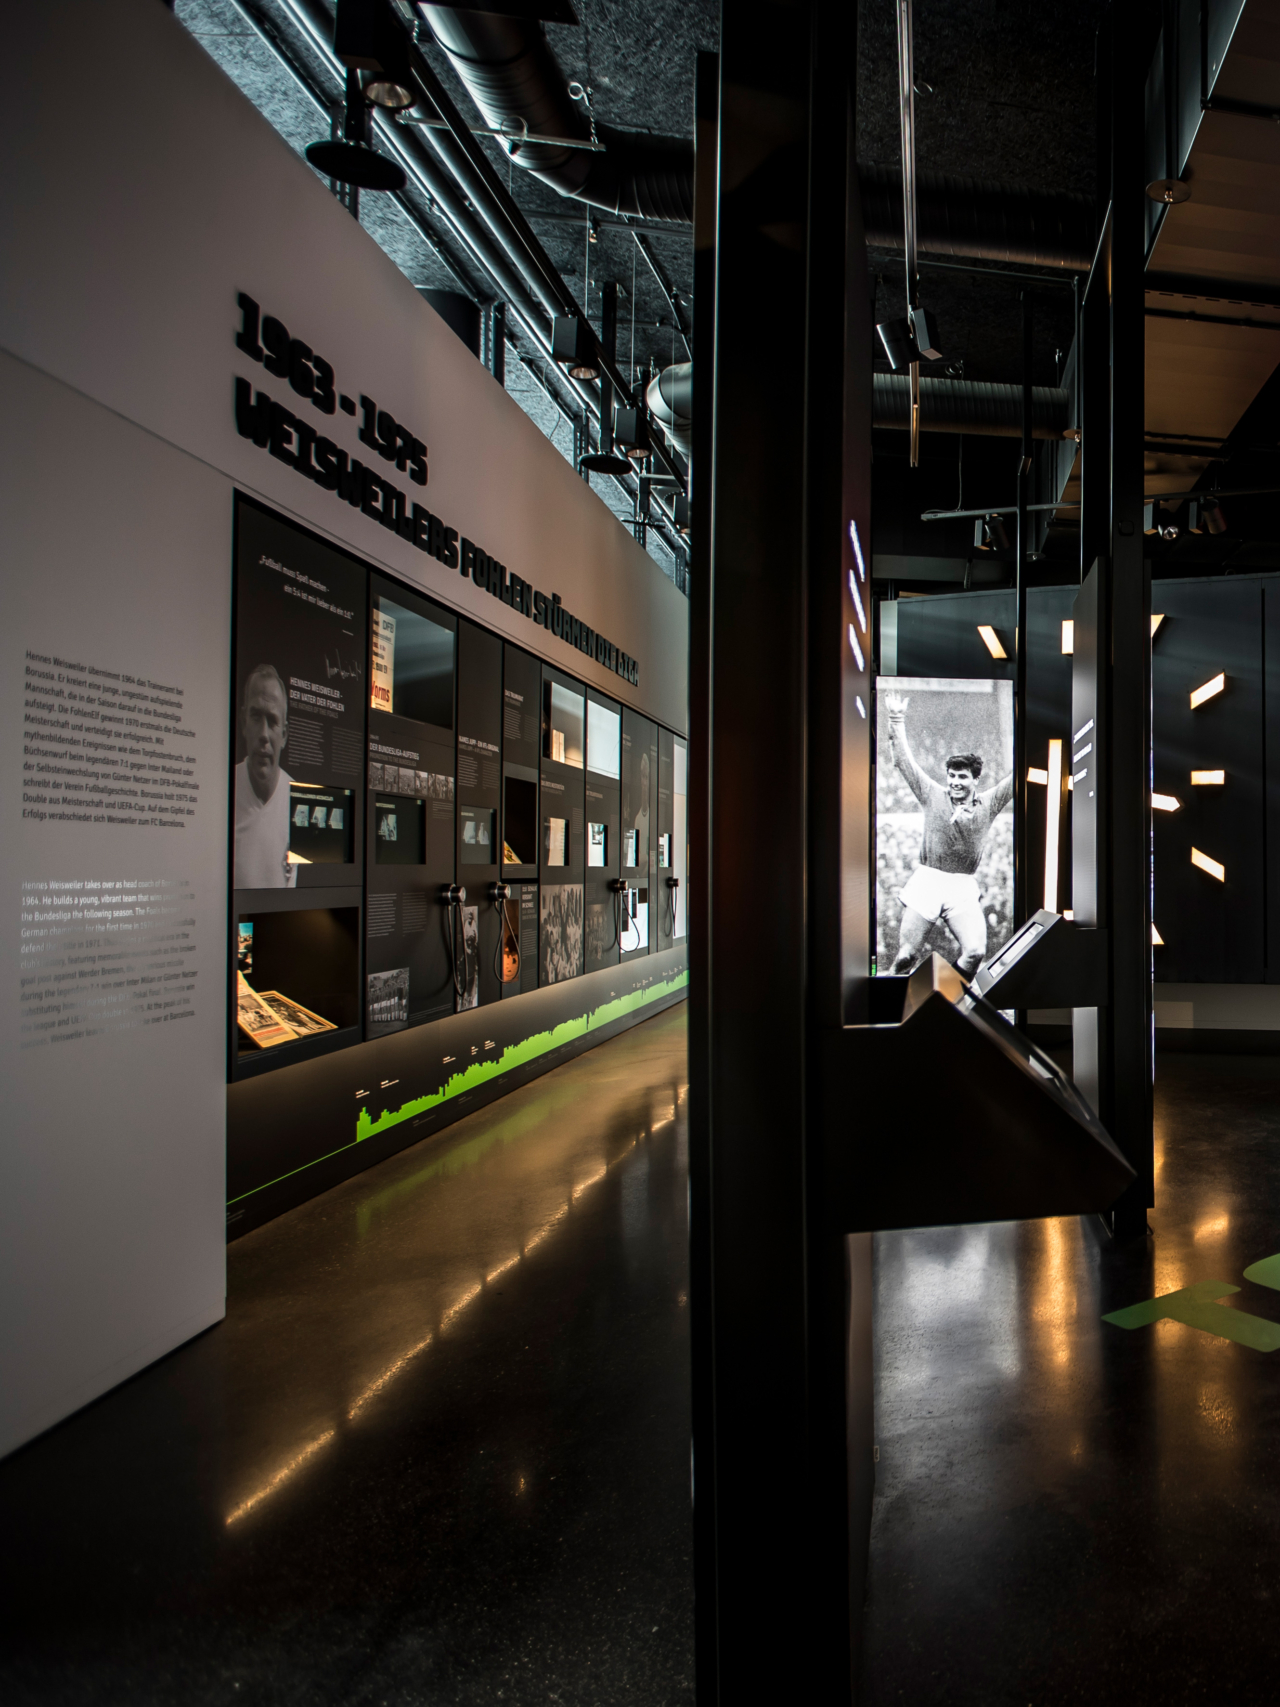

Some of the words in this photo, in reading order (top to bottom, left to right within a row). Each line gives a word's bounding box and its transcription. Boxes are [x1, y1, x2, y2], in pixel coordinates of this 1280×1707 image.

[235, 291, 336, 415] 1963
[339, 393, 356, 416] -
[358, 394, 428, 486] 1975
[234, 376, 459, 569] WEISWEILERS
[460, 536, 533, 618] FOHLEN
[533, 592, 596, 658] STÜRMEN
[595, 633, 617, 672] DIE
[616, 648, 639, 687] LIGA
[25, 650, 51, 664] Hennes
[52, 657, 86, 672] Weisweiler
[87, 666, 120, 680] übernimmt
[121, 674, 135, 683] 1964
[136, 678, 146, 687] das
[25, 665, 56, 680] Borussia.
[57, 673, 65, 682] Er
[66, 675, 87, 687] kreiert
[88, 681, 101, 690] eine
[102, 684, 121, 696] junge,
[25, 681, 66, 698] Mannschaft,
[67, 691, 77, 700] die
[78, 693, 85, 701] in
[85, 694, 96, 704] der
[97, 697, 117, 708] Saison
[118, 702, 136, 712] darauf
[143, 707, 152, 716] die
[290, 676, 311, 690] HENNES
[311, 682, 340, 698] WEISWEILER
[290, 690, 300, 700] DER
[301, 692, 316, 704] VATER
[316, 696, 326, 706] DER
[327, 699, 345, 712] FOHLEN
[24, 699, 56, 713] aufsteigt.
[58, 703, 69, 713] Die
[70, 706, 100, 719] FohlenElf
[100, 714, 124, 724] gewinnt
[125, 717, 139, 727] 1970
[163, 725, 172, 733] die
[24, 713, 69, 728] Meisterschaft
[70, 723, 83, 731] und
[84, 726, 113, 738] verteidigt
[24, 731, 81, 745] mythenbildenden
[82, 738, 117, 751] Ereignissen
[128, 746, 141, 754] dem
[24, 745, 68, 758] Büchsenwurf
[69, 751, 85, 761] beim
[85, 754, 119, 765] legendären
[120, 758, 129, 767] 7:1
[129, 762, 147, 771] gegen
[147, 763, 160, 771] Inter
[161, 765, 182, 774] Mailand
[23, 761, 35, 770] der
[36, 763, 99, 779] Selbsteinwechslung
[112, 772, 132, 781] Günter
[132, 774, 151, 784] Netzer
[23, 777, 51, 787] schreibt
[52, 780, 63, 789] der
[64, 781, 84, 790] Verein
[140, 789, 163, 799] Borussia
[164, 792, 175, 800] holt
[175, 793, 188, 801] 1975
[23, 792, 47, 803] Double
[61, 796, 104, 807] Meisterschaft
[104, 801, 116, 809] und
[117, 801, 146, 812] UEFA-Cup.
[147, 804, 157, 812] Auf
[157, 805, 169, 813] dem
[170, 805, 185, 815] Gipfel
[22, 808, 47, 821] Erfolgs
[48, 812, 93, 821] verabschiedet
[93, 814, 106, 822] sich
[106, 815, 137, 824] Weisweiler
[151, 817, 158, 826] FC
